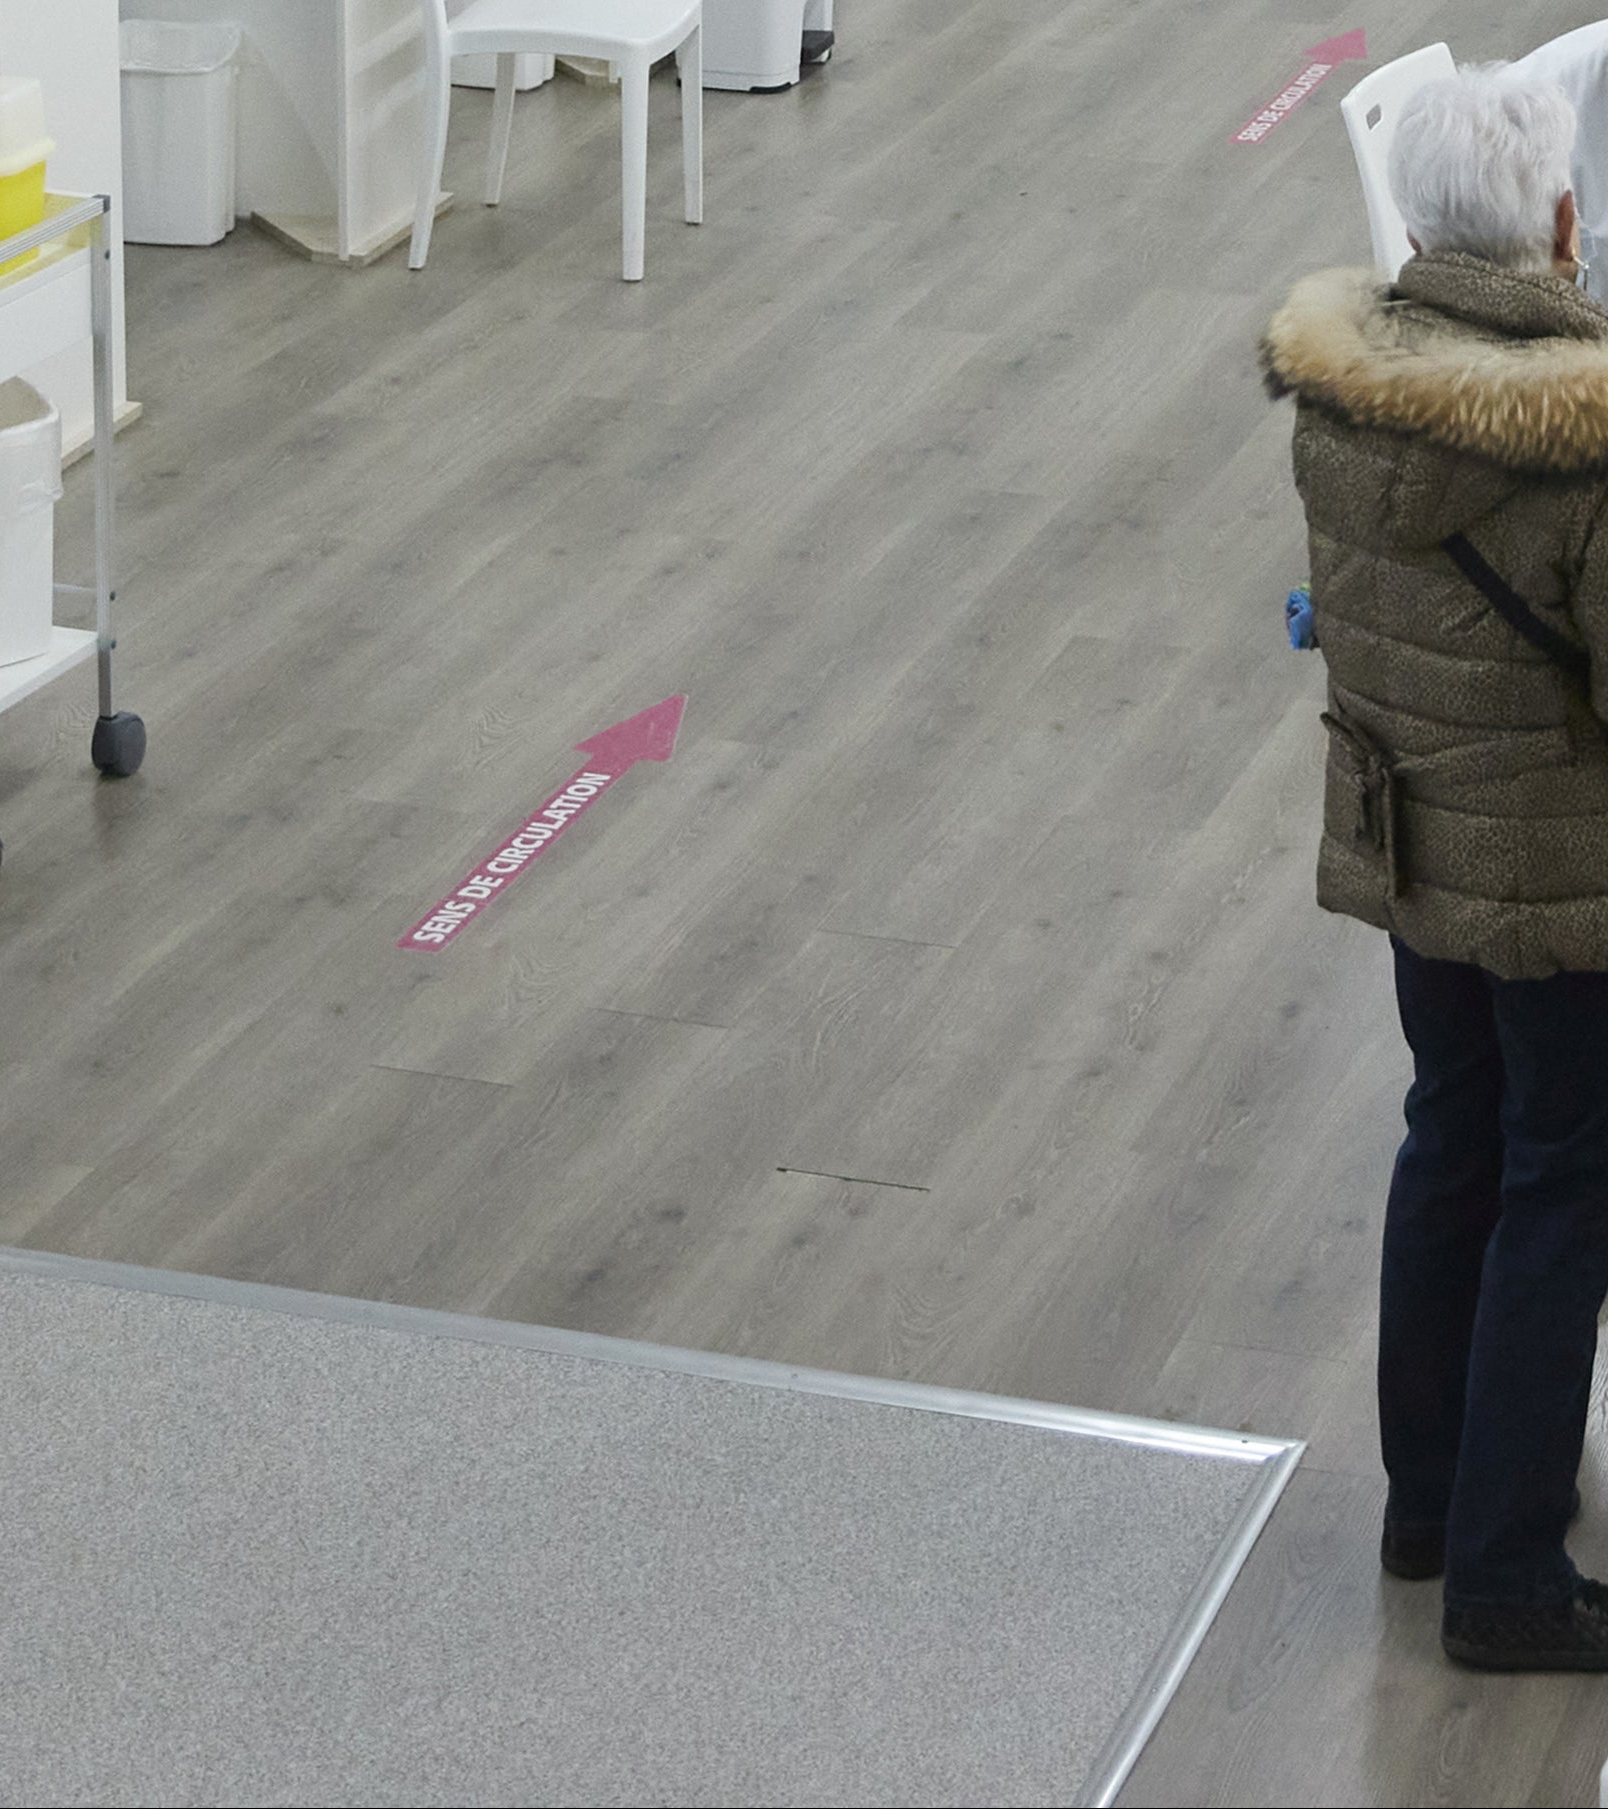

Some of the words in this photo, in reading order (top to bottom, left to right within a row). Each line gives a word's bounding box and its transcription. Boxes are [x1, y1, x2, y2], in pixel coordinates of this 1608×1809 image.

[412, 899, 477, 944] SENS
[457, 874, 505, 900] DE
[486, 771, 612, 874] CIRCULATION
